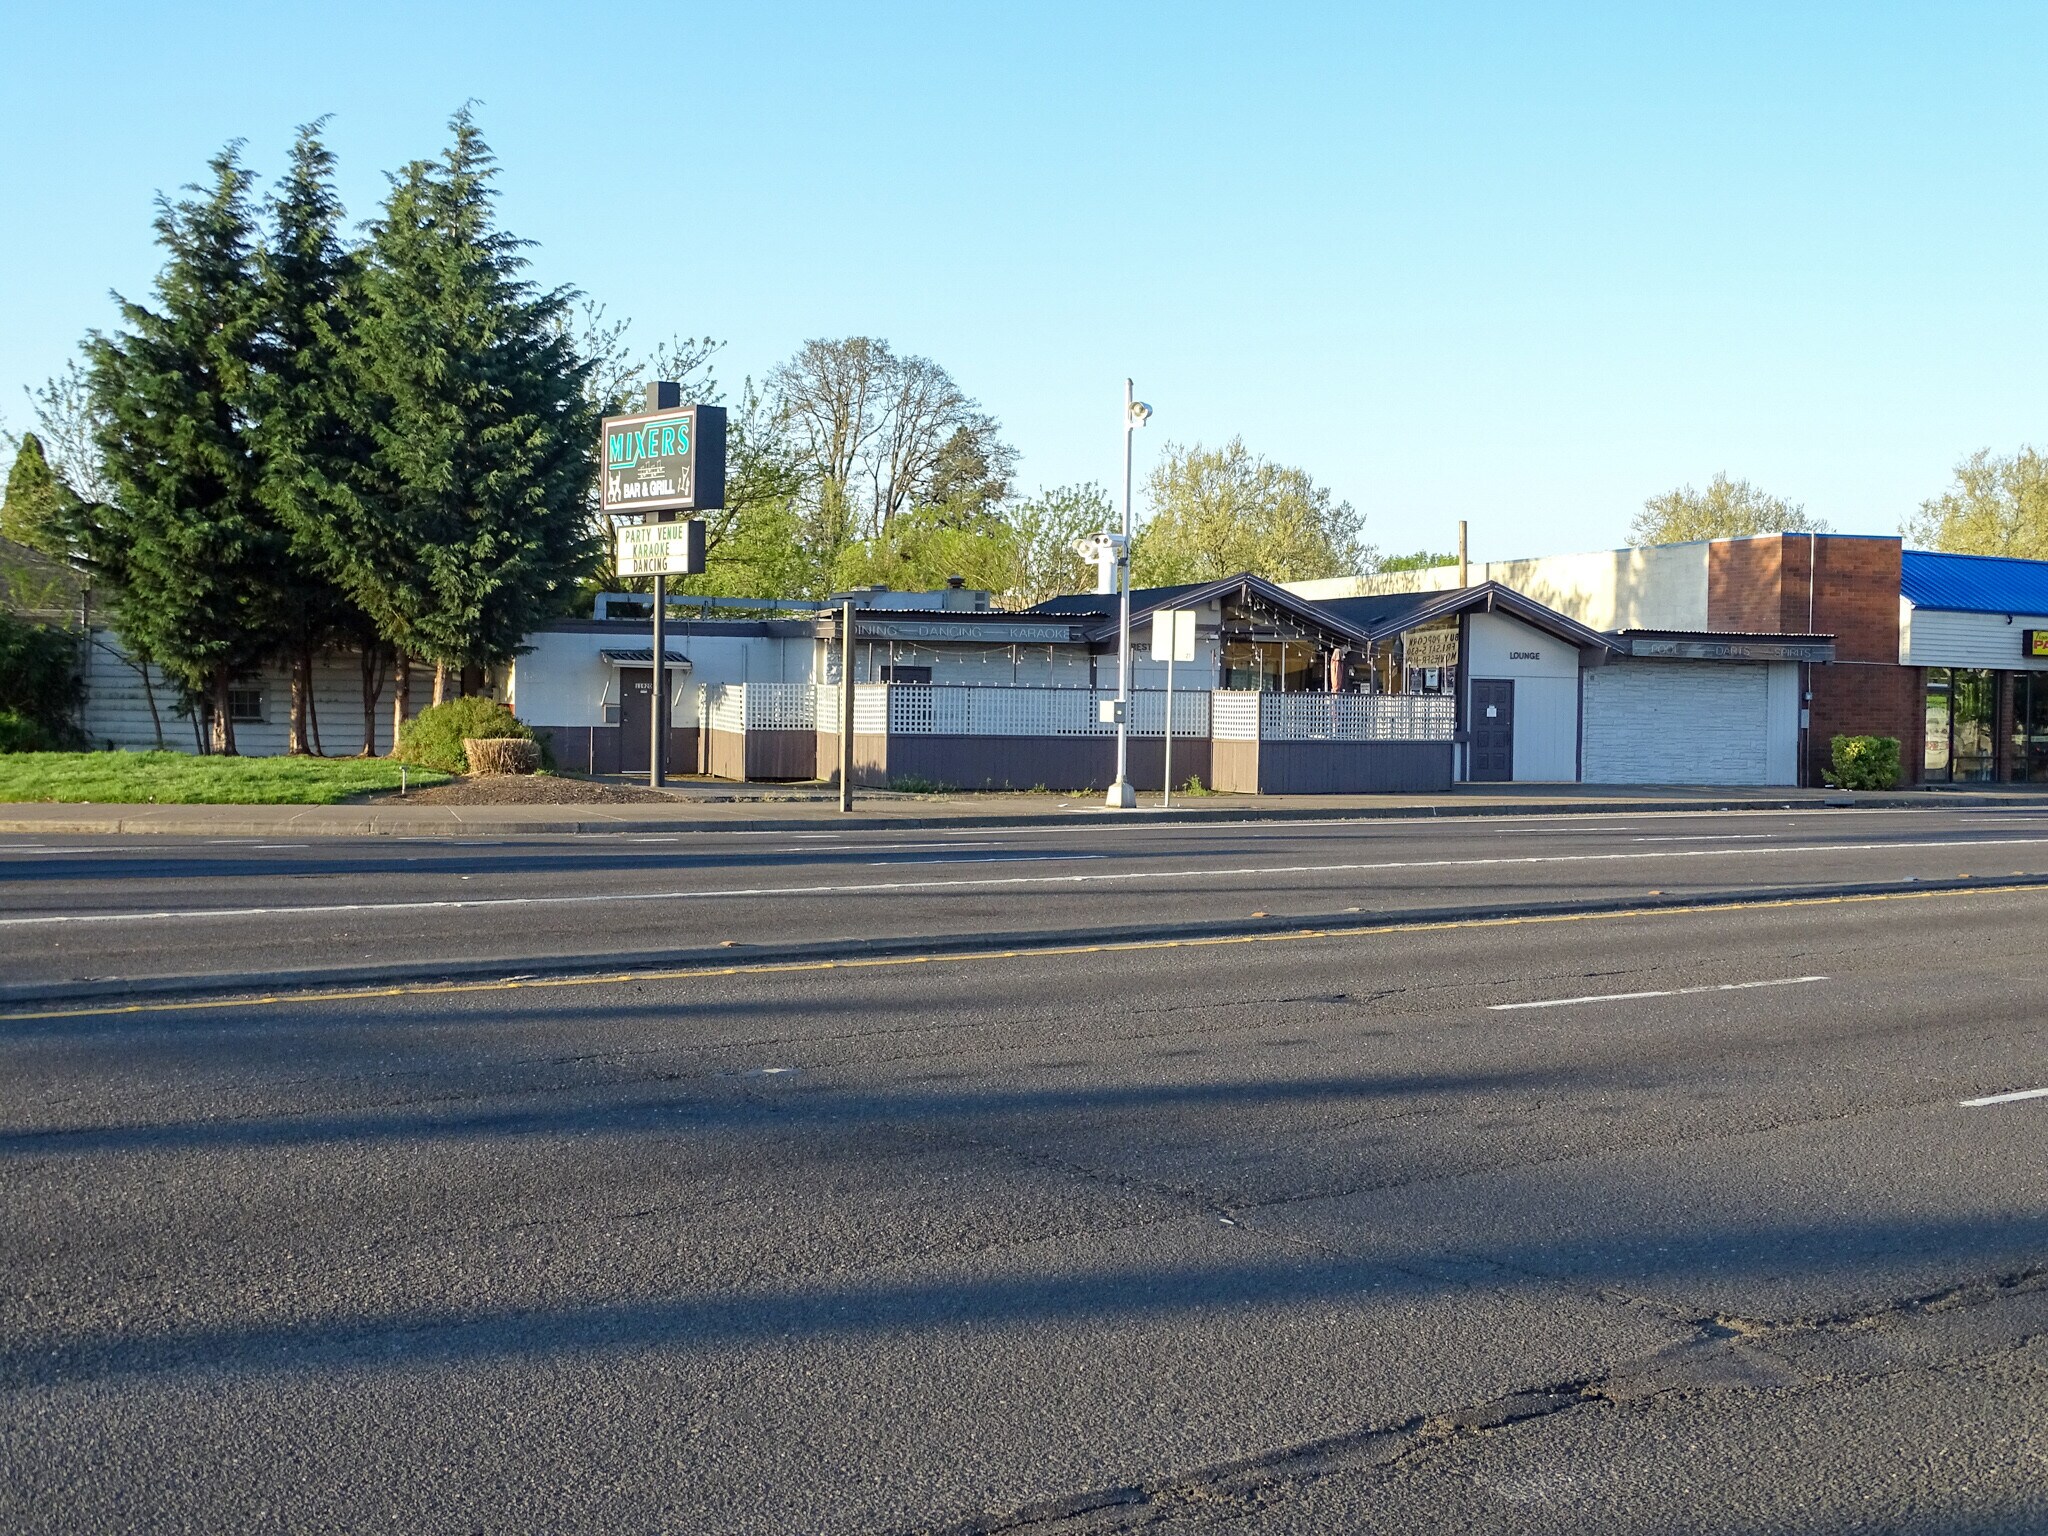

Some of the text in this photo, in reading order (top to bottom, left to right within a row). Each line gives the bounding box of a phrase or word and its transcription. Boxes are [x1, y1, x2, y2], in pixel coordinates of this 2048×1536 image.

[609, 423, 690, 464] MIXERS
[623, 479, 676, 499] BAR & GRILL
[625, 525, 683, 543] PARTY VENUE
[633, 541, 670, 558] KARAOKE
[633, 557, 668, 573] DANCING
[918, 625, 982, 638] DANCING
[1010, 628, 1069, 641] KARAOKE
[1509, 651, 1540, 660] LOUNGE
[1651, 643, 1811, 658] POOL DARTS SPIRITS
